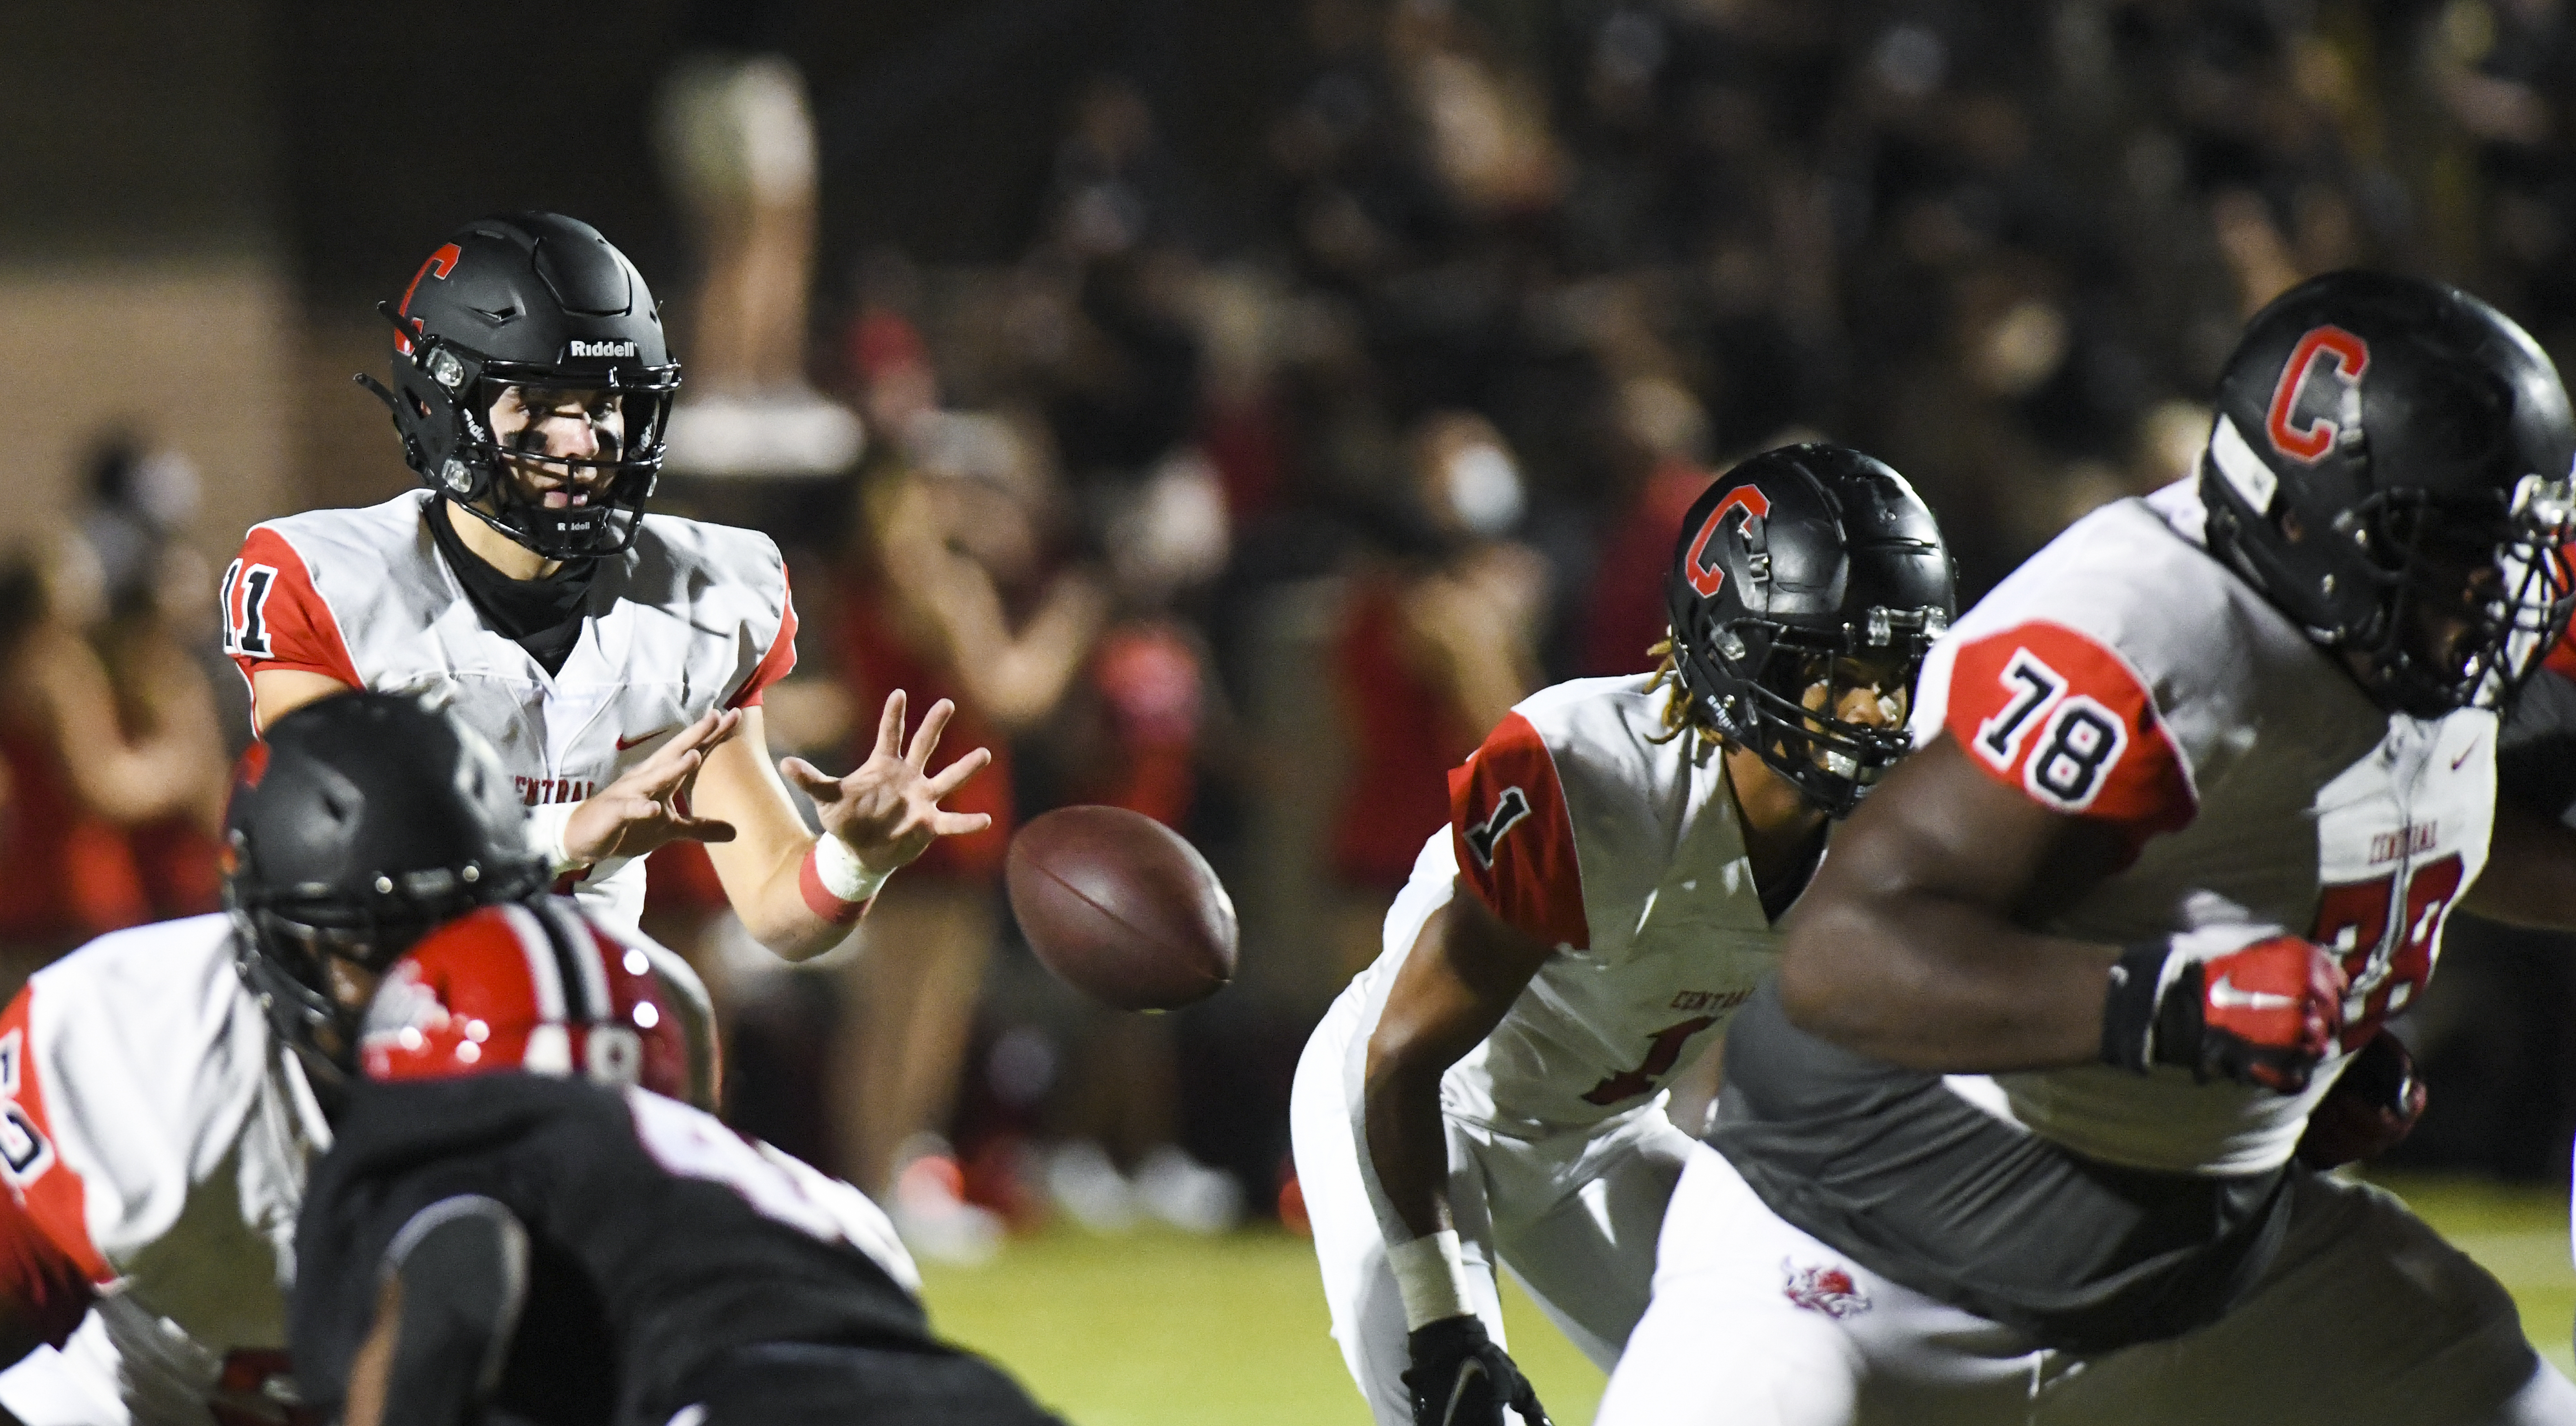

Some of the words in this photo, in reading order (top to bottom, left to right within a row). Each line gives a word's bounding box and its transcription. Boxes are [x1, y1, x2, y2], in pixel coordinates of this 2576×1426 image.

[394, 242, 461, 356] C
[570, 340, 635, 357] Riddell
[2266, 324, 2370, 468] C
[1685, 483, 1771, 599] C
[220, 557, 279, 658] 11
[1972, 645, 2128, 812] 78
[1462, 786, 1532, 871] 1
